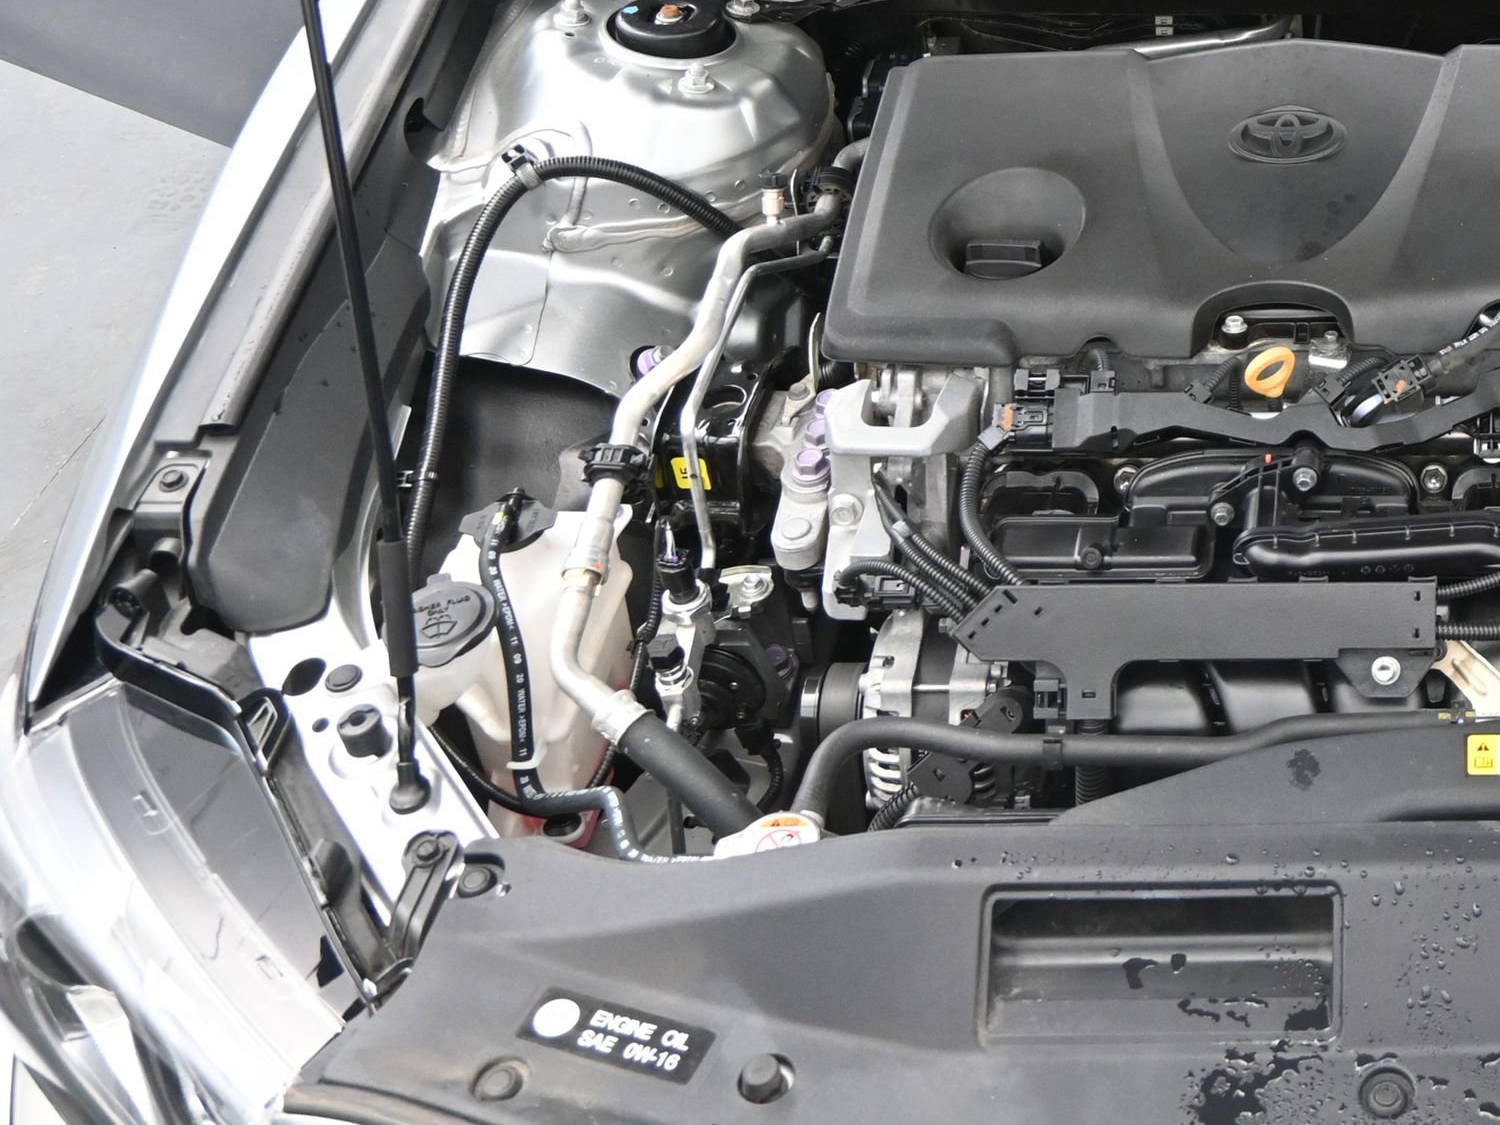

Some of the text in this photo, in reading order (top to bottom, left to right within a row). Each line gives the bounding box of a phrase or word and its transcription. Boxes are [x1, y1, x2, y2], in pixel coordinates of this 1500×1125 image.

[447, 595, 471, 606] FLUID
[493, 578, 507, 602] WATER
[513, 653, 522, 664] 09
[516, 673, 525, 684] 20
[517, 687, 527, 713] WATER
[589, 1009, 689, 1052] ENGINE OIL
[577, 1029, 681, 1071] SAE 0W-16
